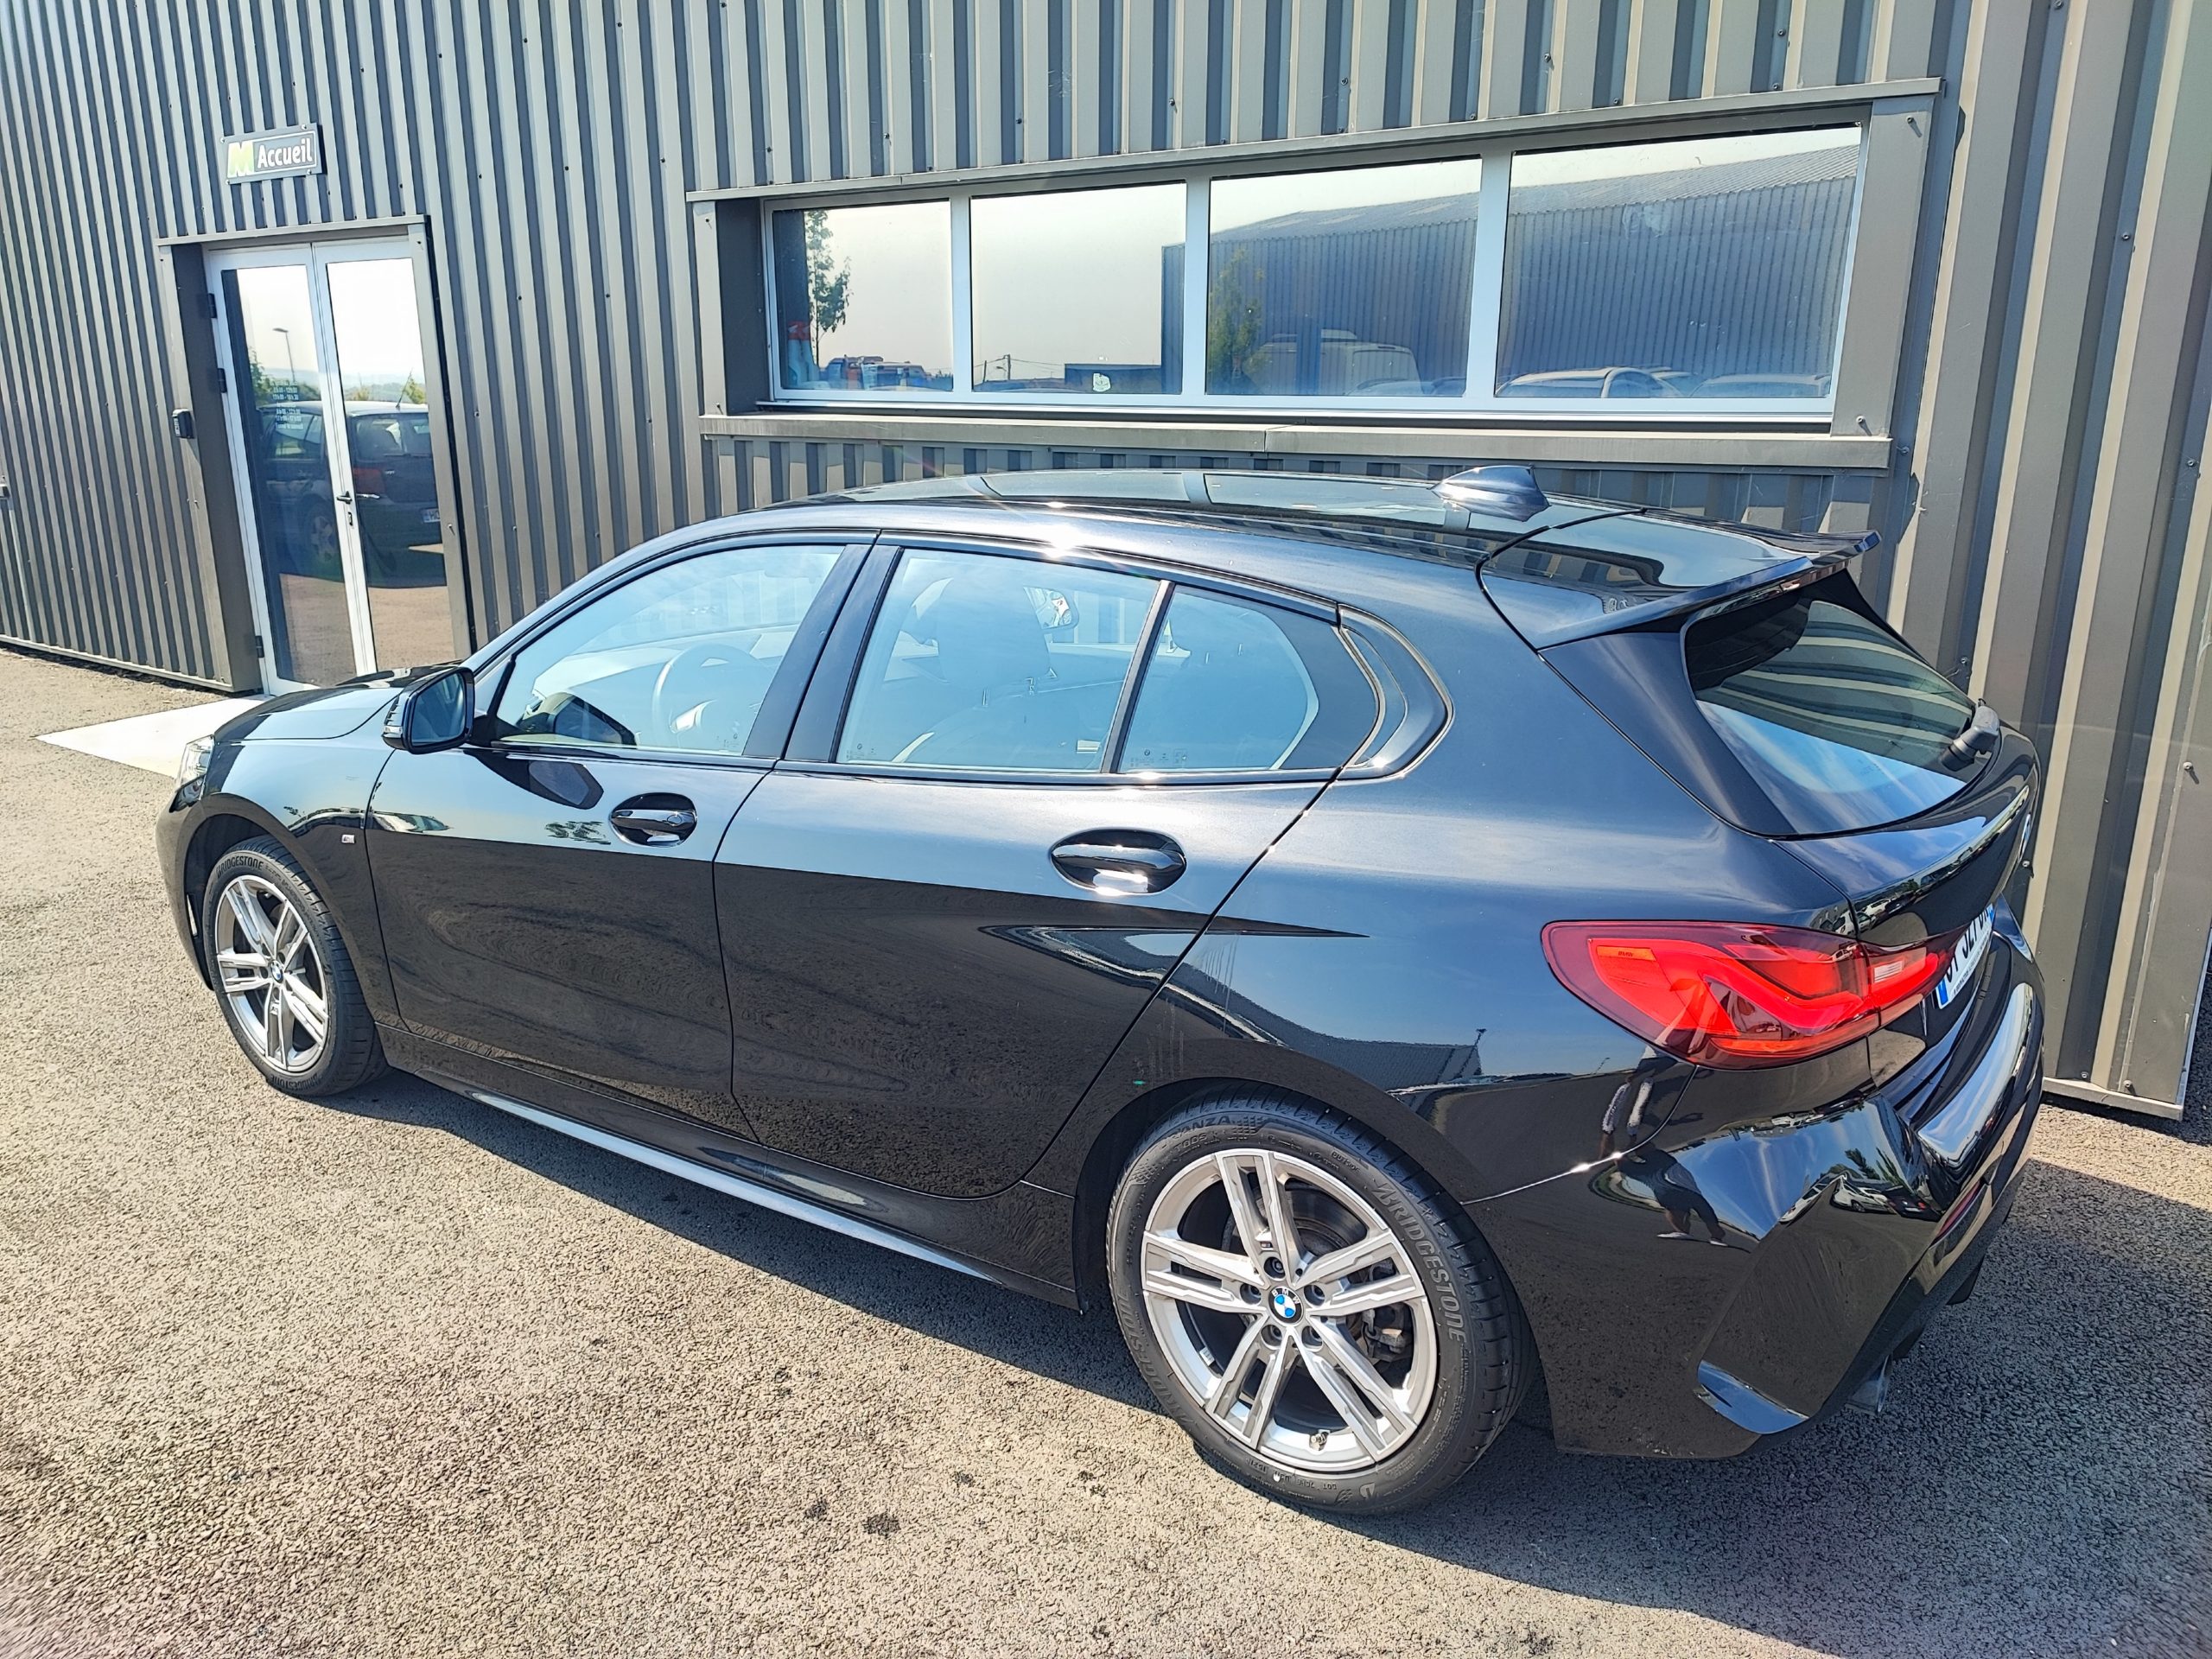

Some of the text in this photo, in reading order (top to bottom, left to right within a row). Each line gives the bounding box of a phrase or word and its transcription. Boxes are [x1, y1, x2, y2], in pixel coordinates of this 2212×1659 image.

[257, 138, 313, 168] Accueil
[216, 855, 264, 878] BRIDGESTONE
[1372, 1180, 1467, 1342] BRIDGESTONE
[1270, 1287, 1301, 1305] BMW
